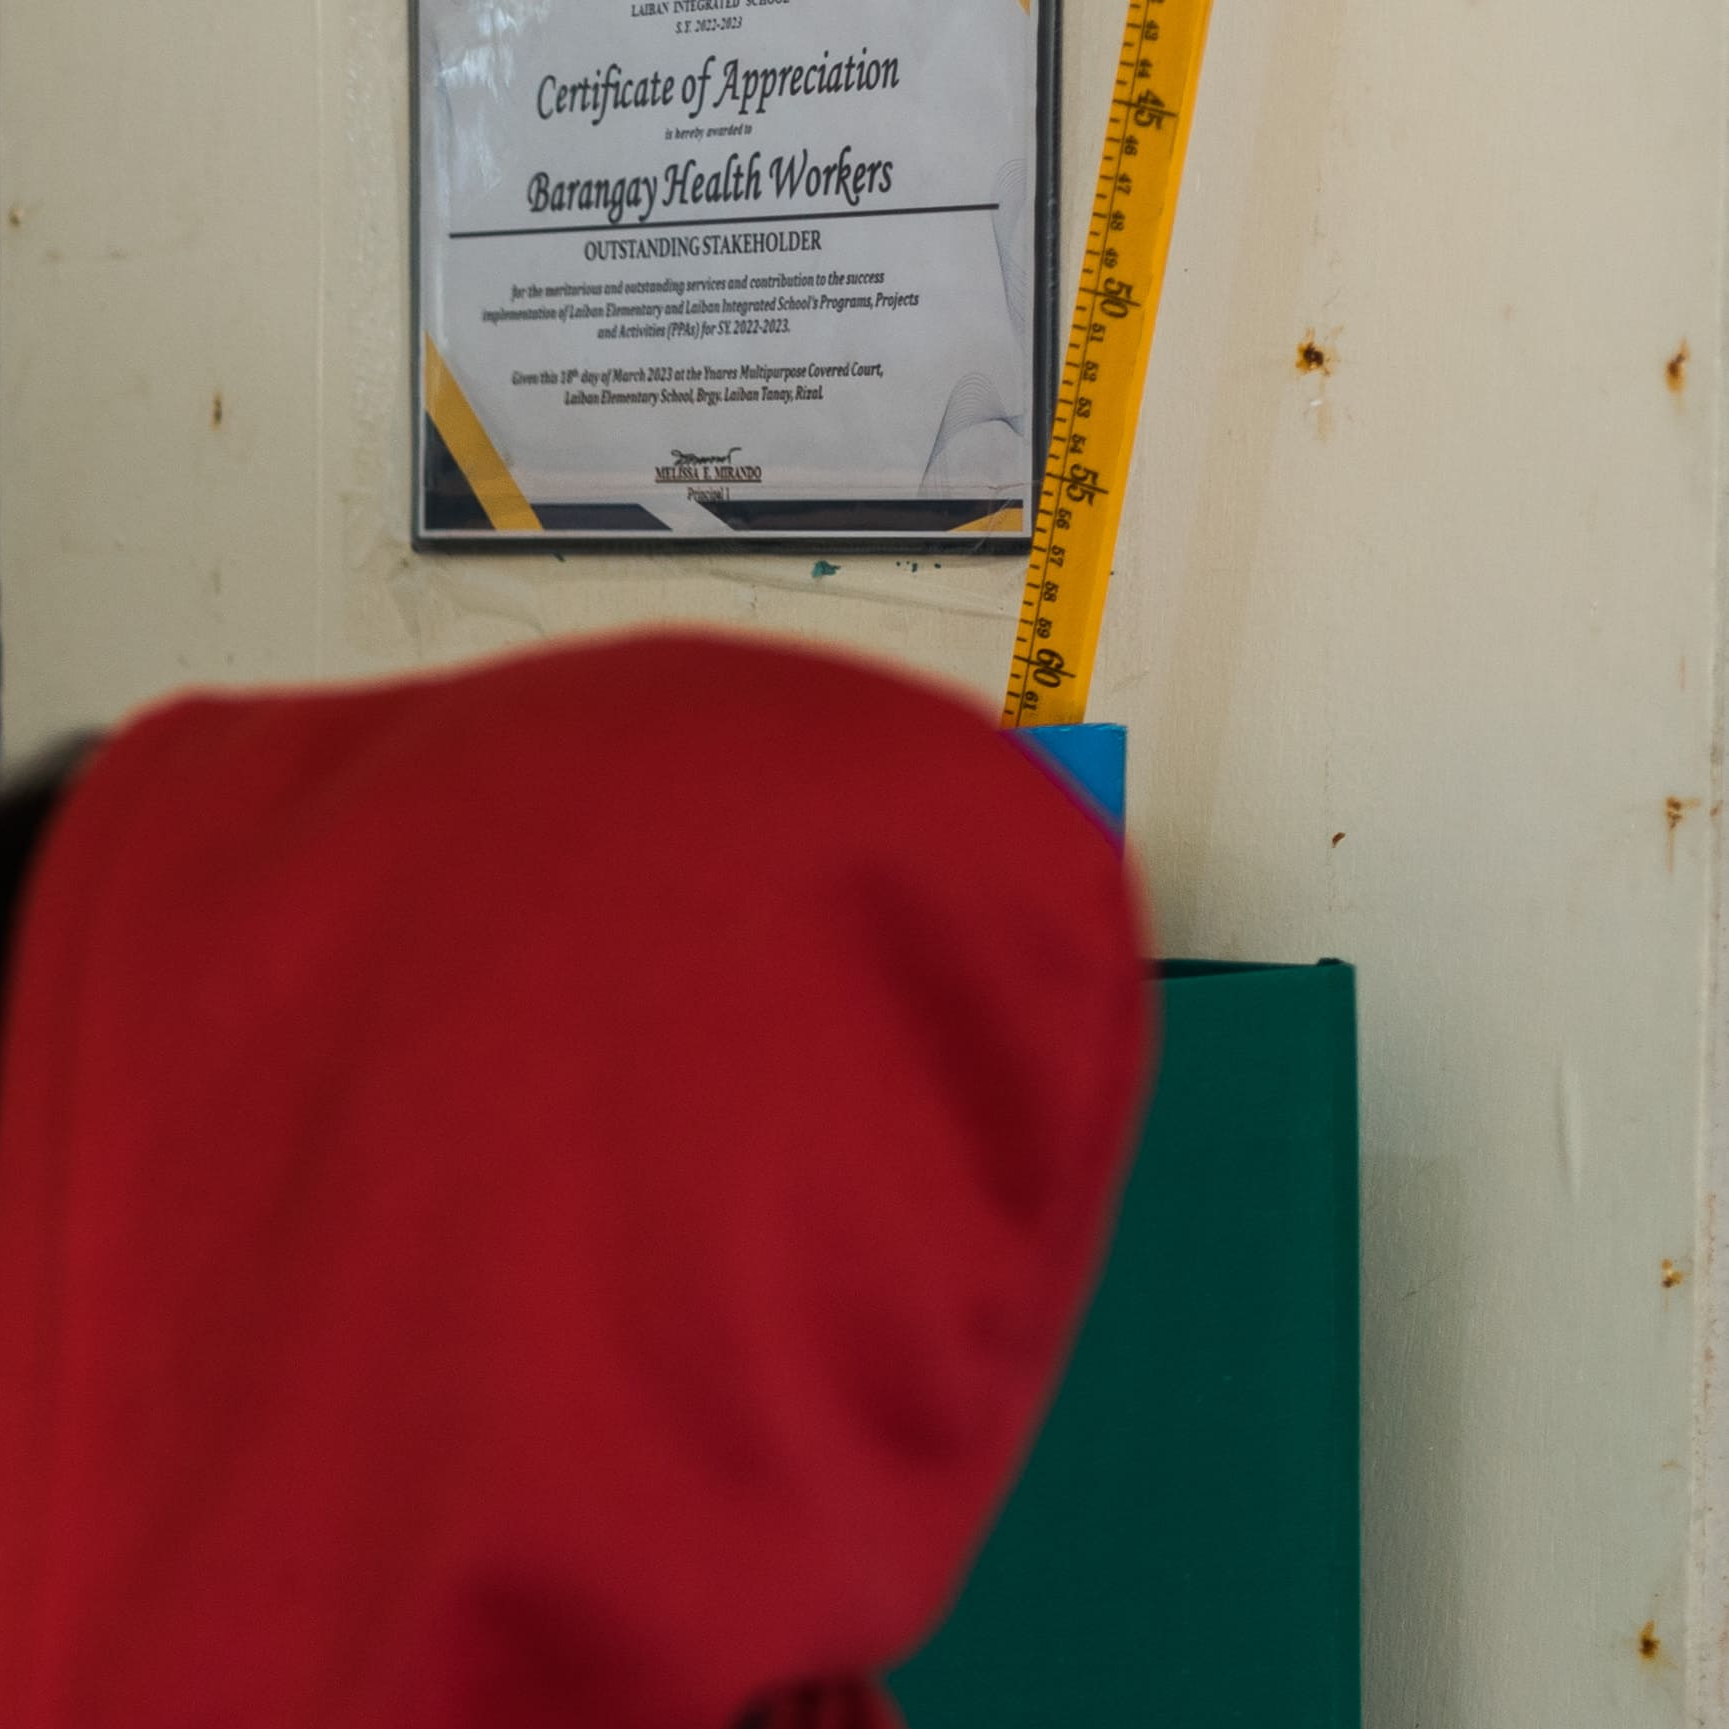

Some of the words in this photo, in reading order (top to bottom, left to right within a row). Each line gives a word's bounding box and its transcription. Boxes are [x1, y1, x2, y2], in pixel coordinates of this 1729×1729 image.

[631, 2, 668, 17] LAIBAN
[674, 0, 739, 13] INTEGRATED
[695, 16, 742, 32] 2022-2023
[536, 63, 673, 125] Certificate
[682, 55, 716, 119] of
[713, 48, 900, 115] Appreciation
[1133, 89, 1166, 130] 45
[675, 125, 704, 142] hereby
[706, 123, 743, 138] awarded
[528, 171, 657, 225] Barangay
[663, 151, 761, 207] Health
[769, 145, 893, 207] Workers
[1117, 172, 1132, 195] 47
[1110, 210, 1125, 232] 48
[584, 236, 701, 261] OUTSTANDING
[703, 230, 822, 255] STAKEHOLDER
[1103, 247, 1118, 269] 49
[528, 284, 543, 298] the
[545, 281, 602, 297] meritorious
[604, 281, 623, 295] and
[625, 278, 686, 296] outstanding
[686, 276, 726, 292] services
[728, 275, 747, 289] and
[750, 272, 814, 289] contribution
[815, 274, 826, 286] to
[828, 270, 844, 286] the
[846, 271, 885, 285] success
[606, 302, 664, 319] Elementary
[665, 301, 685, 315] and
[685, 300, 721, 315] Laiban
[722, 297, 777, 316] Integrated
[820, 294, 874, 313] Programs,
[875, 292, 919, 310] Projects
[1100, 277, 1134, 319] 50
[598, 325, 617, 340] and
[619, 324, 665, 339] Activities
[700, 321, 716, 339] for
[1091, 322, 1106, 343] 51
[581, 369, 598, 386] day
[600, 368, 612, 387] of
[613, 367, 645, 383] March
[647, 367, 673, 382] 2023
[674, 368, 685, 381] at
[686, 366, 702, 381] the
[703, 365, 737, 381] Ynares
[741, 363, 806, 382] Multipurpose
[808, 361, 850, 378] Covered
[851, 361, 883, 378] Court,
[1082, 360, 1099, 382] 52
[564, 390, 600, 406] Laiban
[601, 388, 658, 407] Elementary
[724, 387, 759, 402] Laiban
[1076, 396, 1092, 418] 53
[1070, 433, 1086, 455] 54
[655, 466, 699, 480] MELISSA
[714, 466, 762, 480] MIRANDO
[1066, 463, 1099, 506] 55
[1056, 508, 1072, 531] 56
[1049, 544, 1065, 568] 57
[1043, 580, 1059, 603] 58
[1037, 617, 1053, 639] 59
[1033, 648, 1065, 689] 60
[1023, 690, 1039, 712] 61
